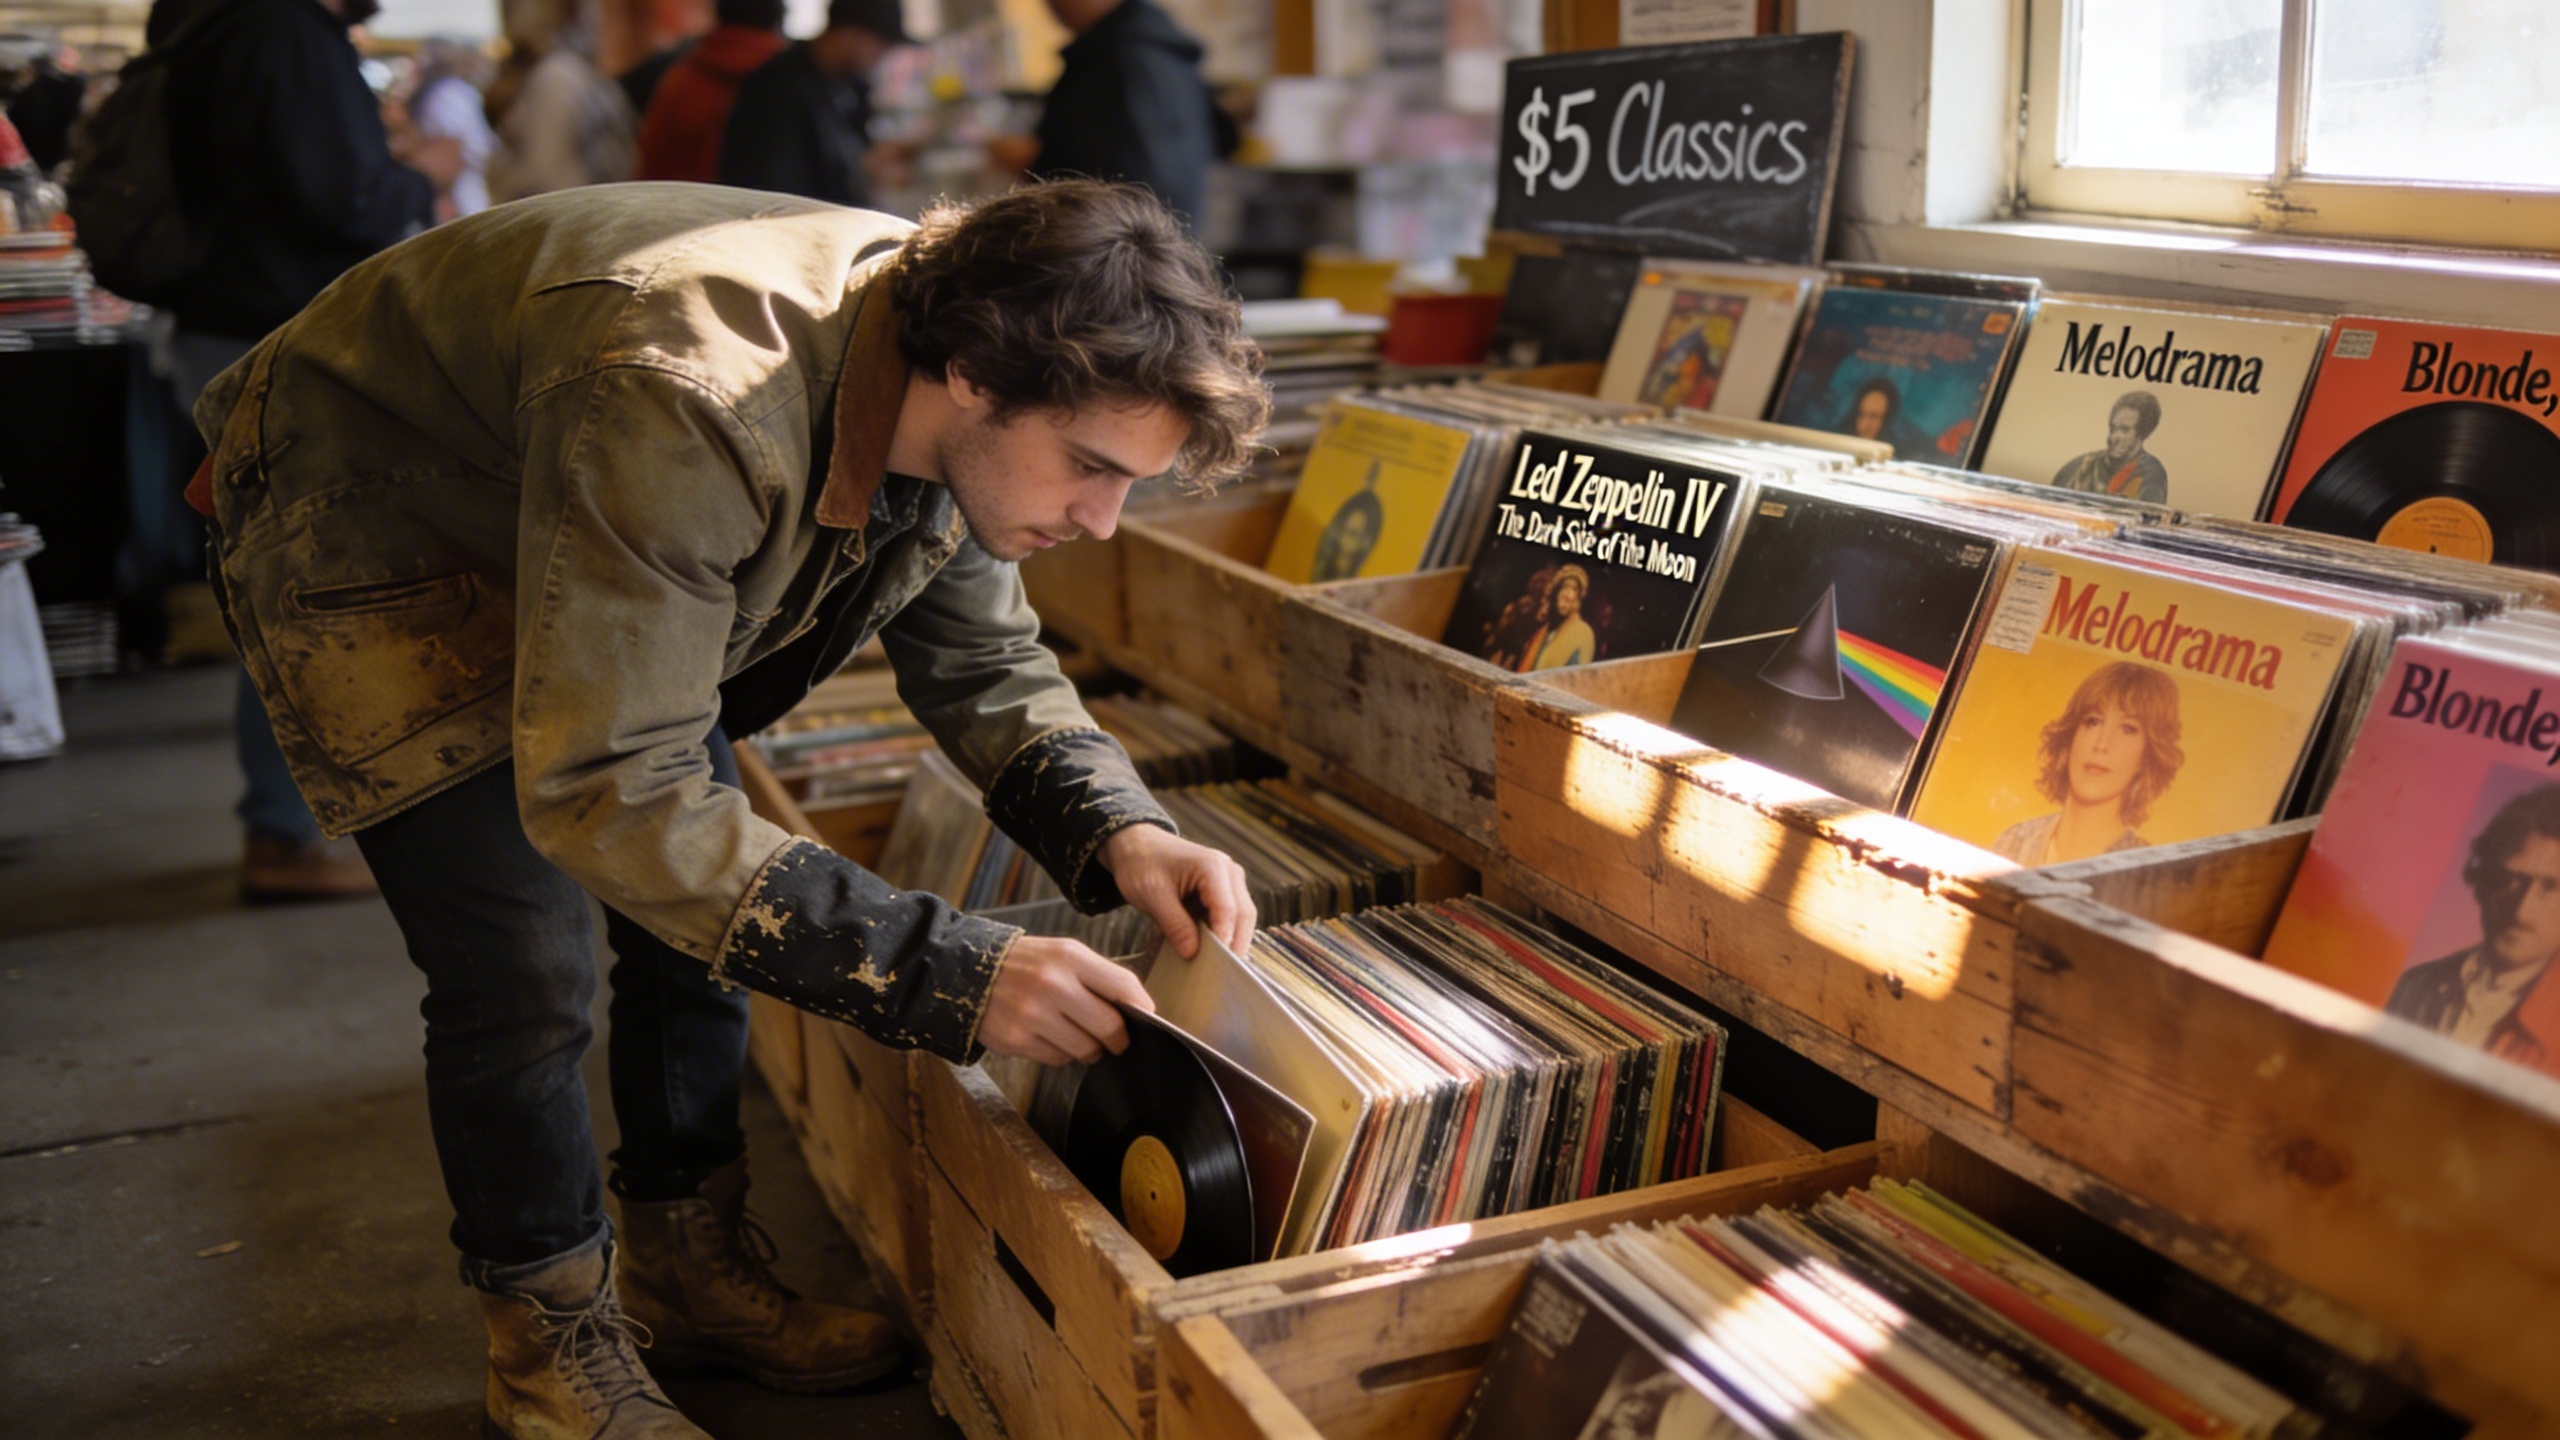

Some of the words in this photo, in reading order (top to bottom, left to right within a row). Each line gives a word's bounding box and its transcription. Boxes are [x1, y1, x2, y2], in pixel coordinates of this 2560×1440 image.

[1513, 86, 1597, 197] $5
[1607, 79, 1808, 185] Classics
[2054, 321, 2264, 395] Melodrama
[2401, 341, 2559, 418] Blonde,
[1509, 444, 1568, 504] Led
[1558, 454, 1676, 530] Zeppelin
[1676, 478, 1728, 539] IV
[1497, 503, 1525, 539] The
[1597, 531, 1621, 564] of
[1646, 539, 1697, 584] Moon
[2041, 575, 2283, 691] Melodrama
